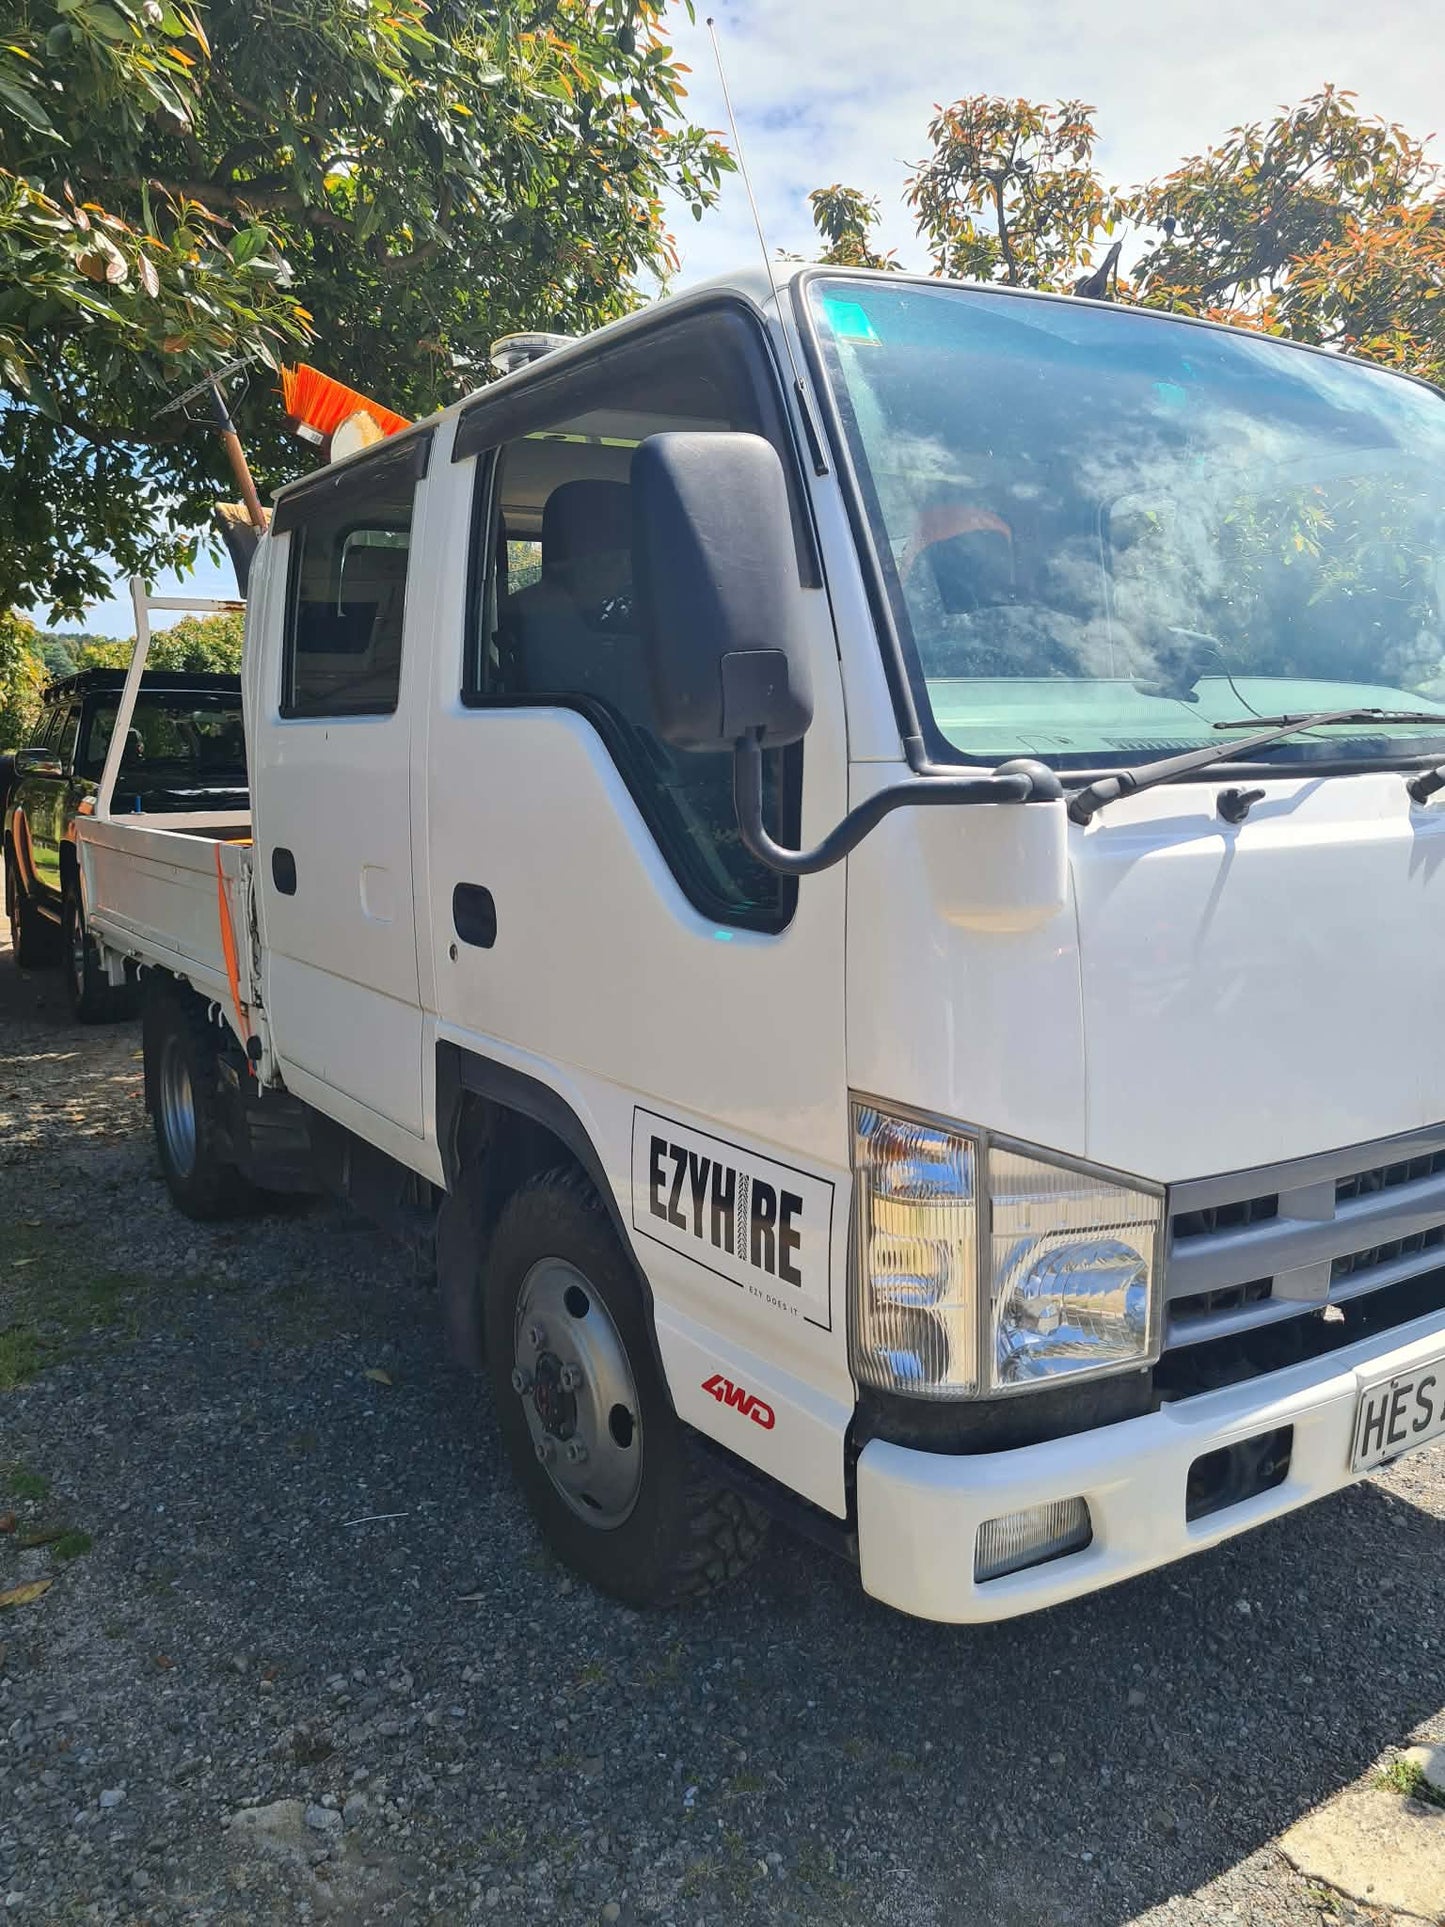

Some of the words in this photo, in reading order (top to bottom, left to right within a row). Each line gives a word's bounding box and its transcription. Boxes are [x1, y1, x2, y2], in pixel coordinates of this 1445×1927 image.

[650, 1135, 803, 1288] EZYHIRE
[749, 1286, 762, 1299] EZY
[766, 1294, 787, 1311] DOES
[790, 1306, 798, 1316] IT
[701, 1374, 776, 1430] 4WD
[1361, 1375, 1445, 1457] HES
